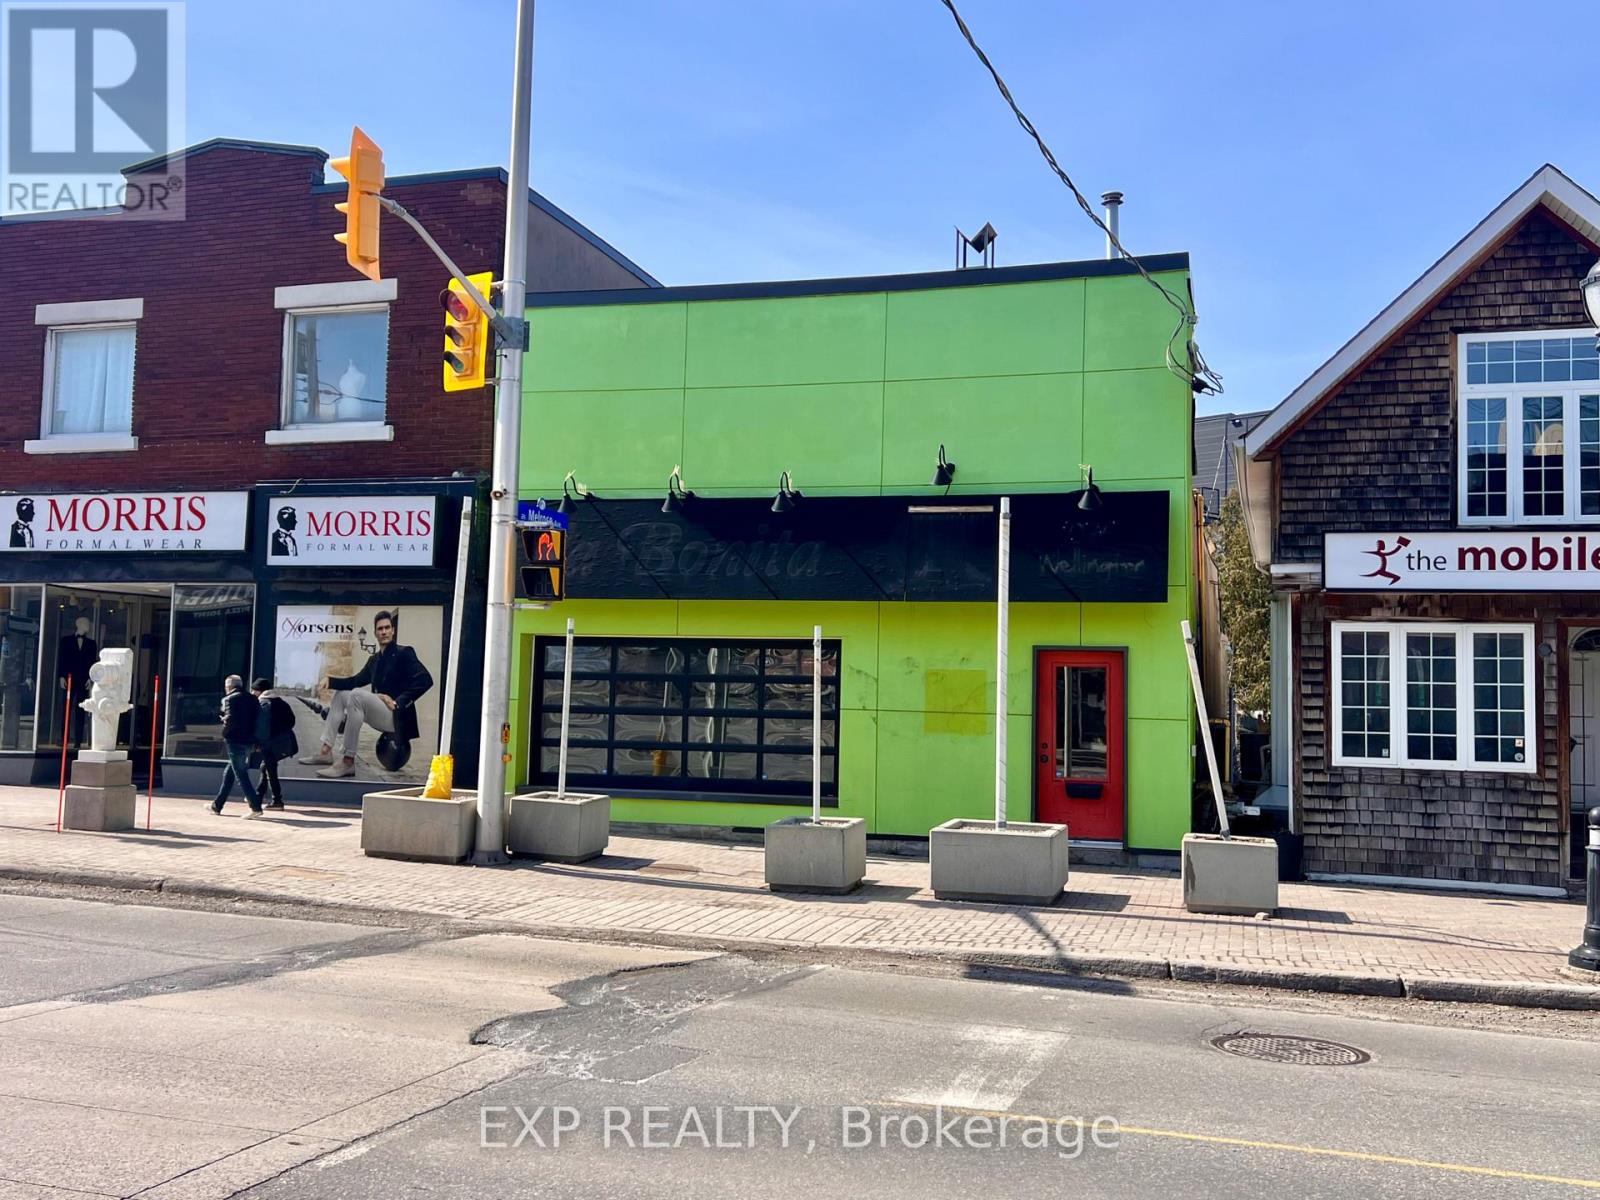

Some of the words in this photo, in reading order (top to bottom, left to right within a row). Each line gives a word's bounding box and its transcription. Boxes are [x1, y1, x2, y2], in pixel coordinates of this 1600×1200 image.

[46, 496, 206, 531] MORRIS
[306, 510, 431, 536] MORRIS
[1406, 549, 1447, 571] the
